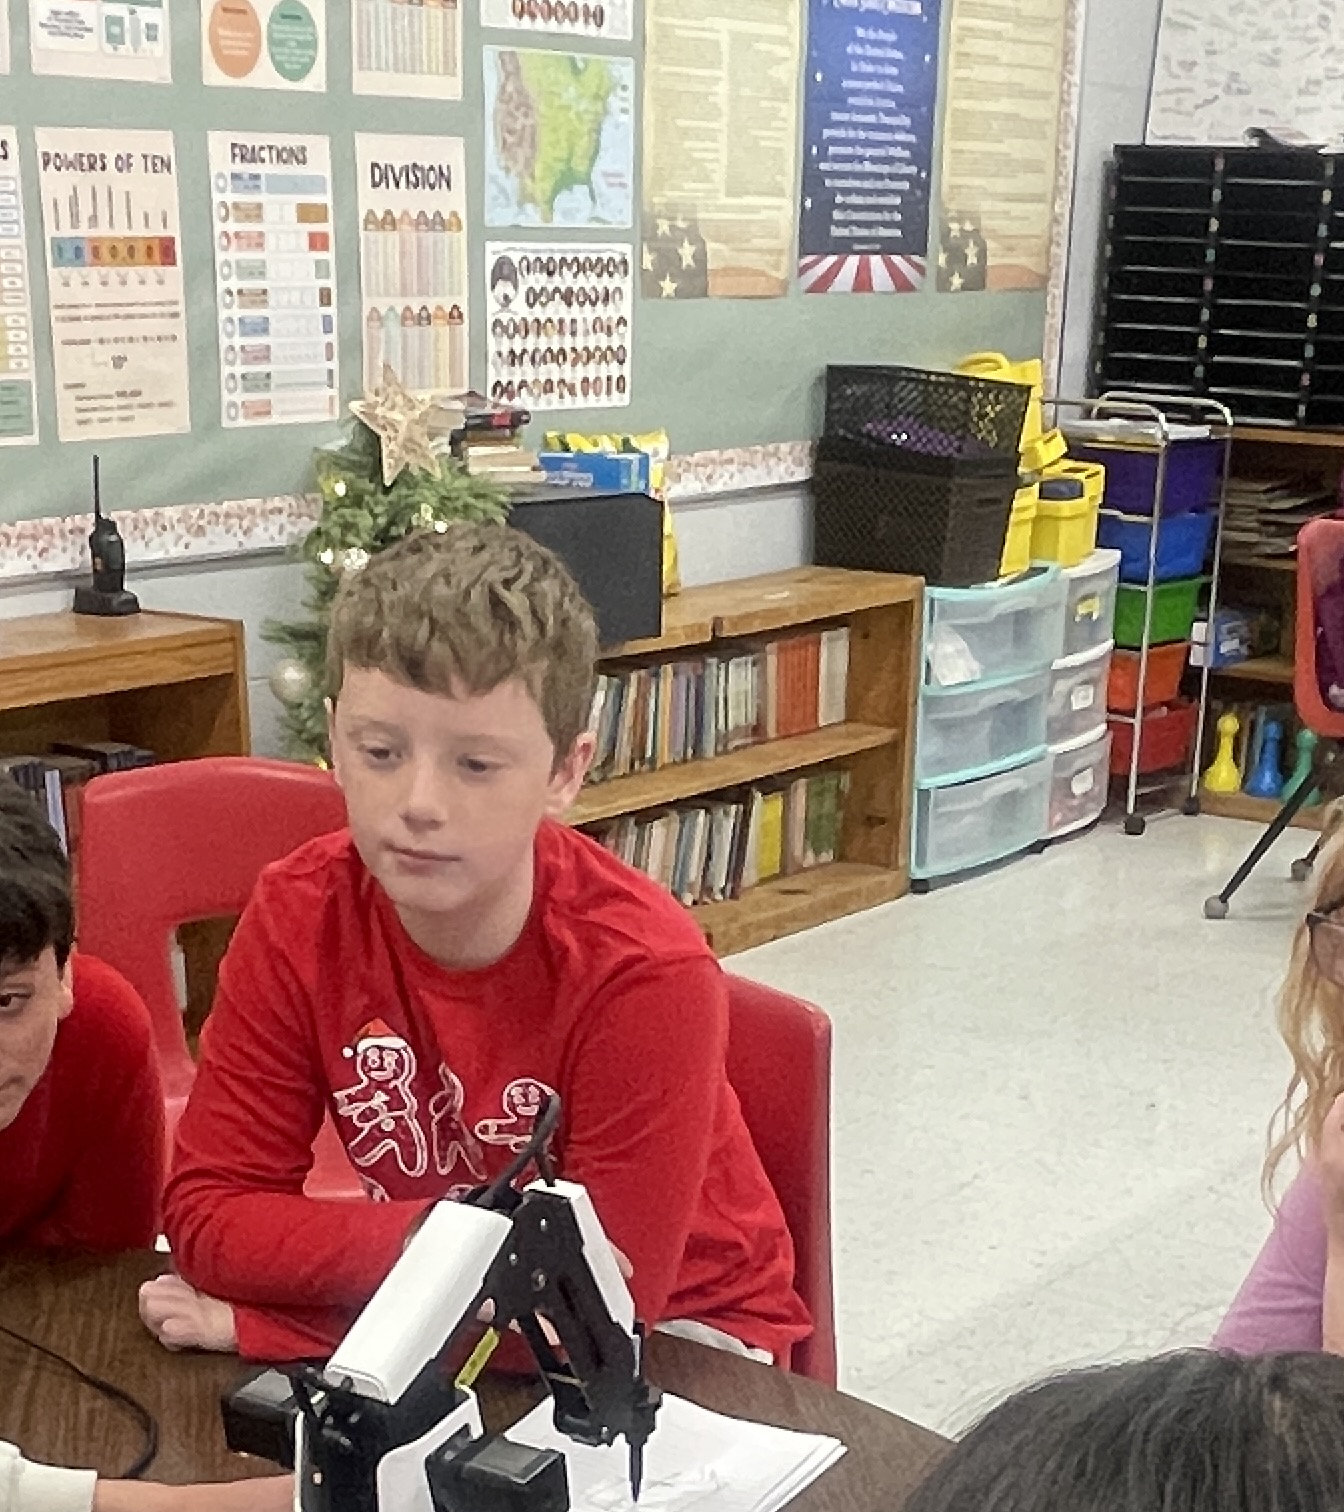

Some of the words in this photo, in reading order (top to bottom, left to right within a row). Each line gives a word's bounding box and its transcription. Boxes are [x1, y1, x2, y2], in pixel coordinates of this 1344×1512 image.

[42, 151, 107, 173] POWERS
[115, 152, 133, 173] OF
[141, 153, 172, 175] TEN
[230, 142, 307, 166] FRACTIONS
[370, 162, 452, 192] DIVISION
